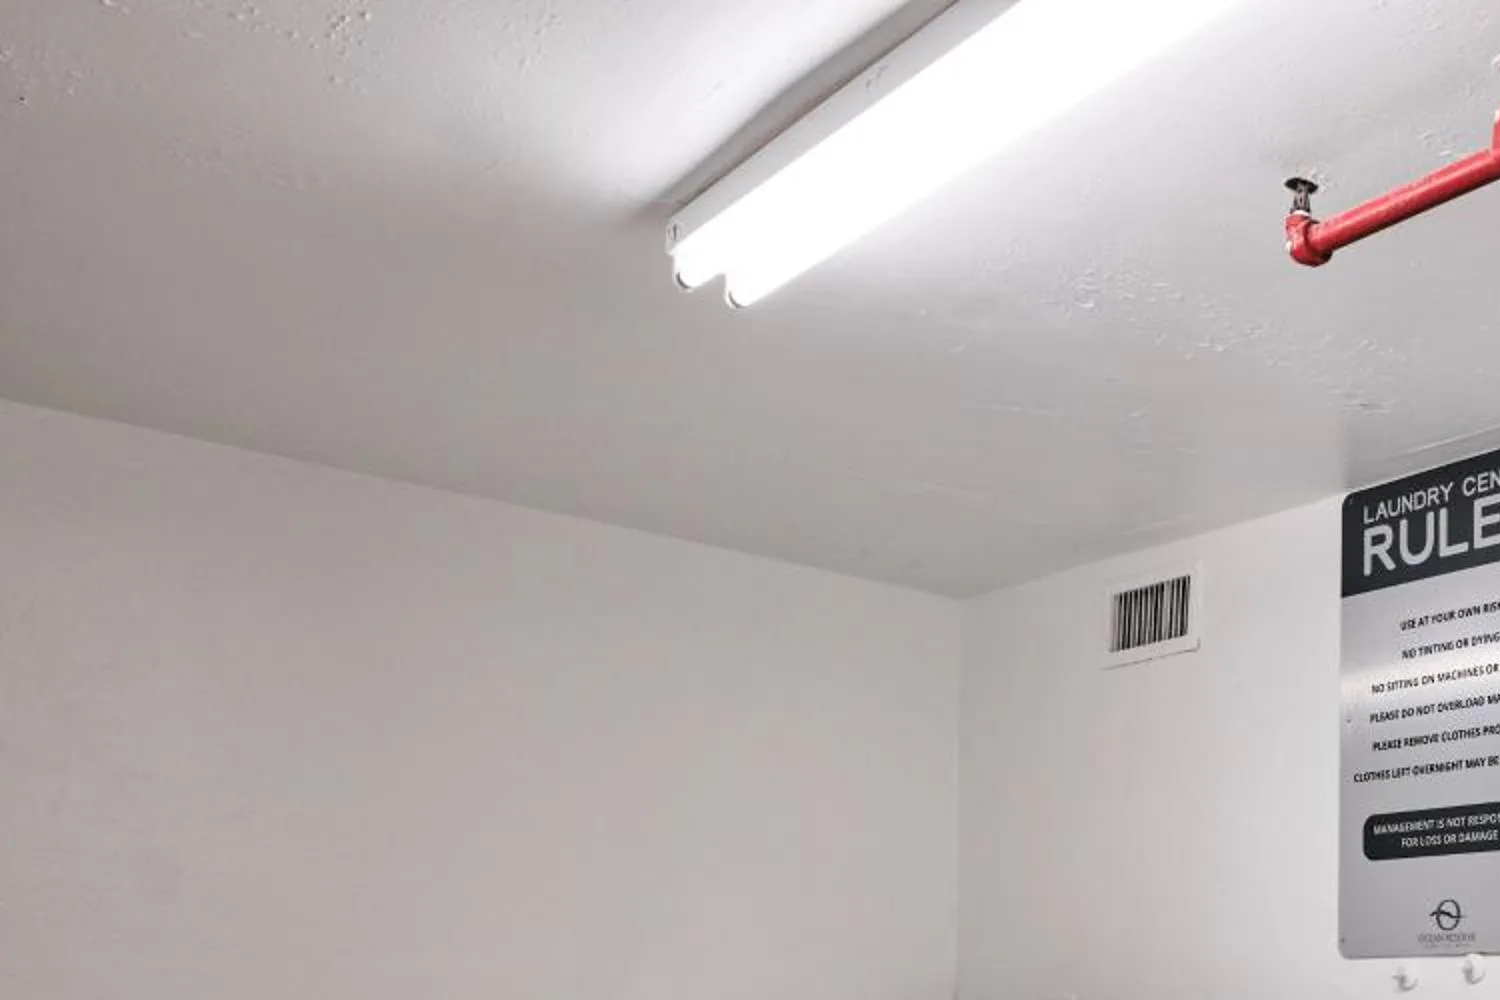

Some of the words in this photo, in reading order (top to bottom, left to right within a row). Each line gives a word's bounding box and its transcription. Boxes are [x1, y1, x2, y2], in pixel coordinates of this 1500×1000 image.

[1363, 481, 1453, 525] LAUNDRY
[1400, 619, 1416, 631] USE
[1418, 616, 1429, 627] AT
[1431, 610, 1456, 624] YOUR
[1457, 605, 1481, 619] OWN
[1402, 648, 1416, 660] NO
[1418, 641, 1454, 656] TINTING
[1456, 638, 1469, 649] OR
[1471, 632, 1500, 646] DYING
[1371, 684, 1385, 694] NO
[1386, 677, 1419, 692] SITTING
[1421, 674, 1435, 685] ON
[1437, 664, 1484, 682] MACHINES
[1486, 662, 1499, 673] OR
[1370, 707, 1400, 723] PLEASE
[1401, 707, 1414, 719] DO
[1416, 704, 1435, 717] NOT
[1437, 695, 1485, 713] OVERLOAD
[1372, 738, 1402, 751] PLEASE
[1404, 733, 1439, 748] REMOVE
[1441, 727, 1481, 742] CLOTHES
[1353, 767, 1391, 783] CLOTHES
[1392, 766, 1411, 779] LEFT
[1412, 759, 1464, 777] OVERNIGHT
[1465, 755, 1486, 769] MAY
[1487, 754, 1499, 766] BE
[1373, 818, 1435, 835] MANAGEMENT
[1436, 818, 1445, 829] IS
[1446, 815, 1466, 828] NOT
[1401, 836, 1419, 848] FOR
[1420, 833, 1442, 846] LOSS
[1443, 832, 1457, 844] OR
[1458, 829, 1499, 843] DAMAGE
